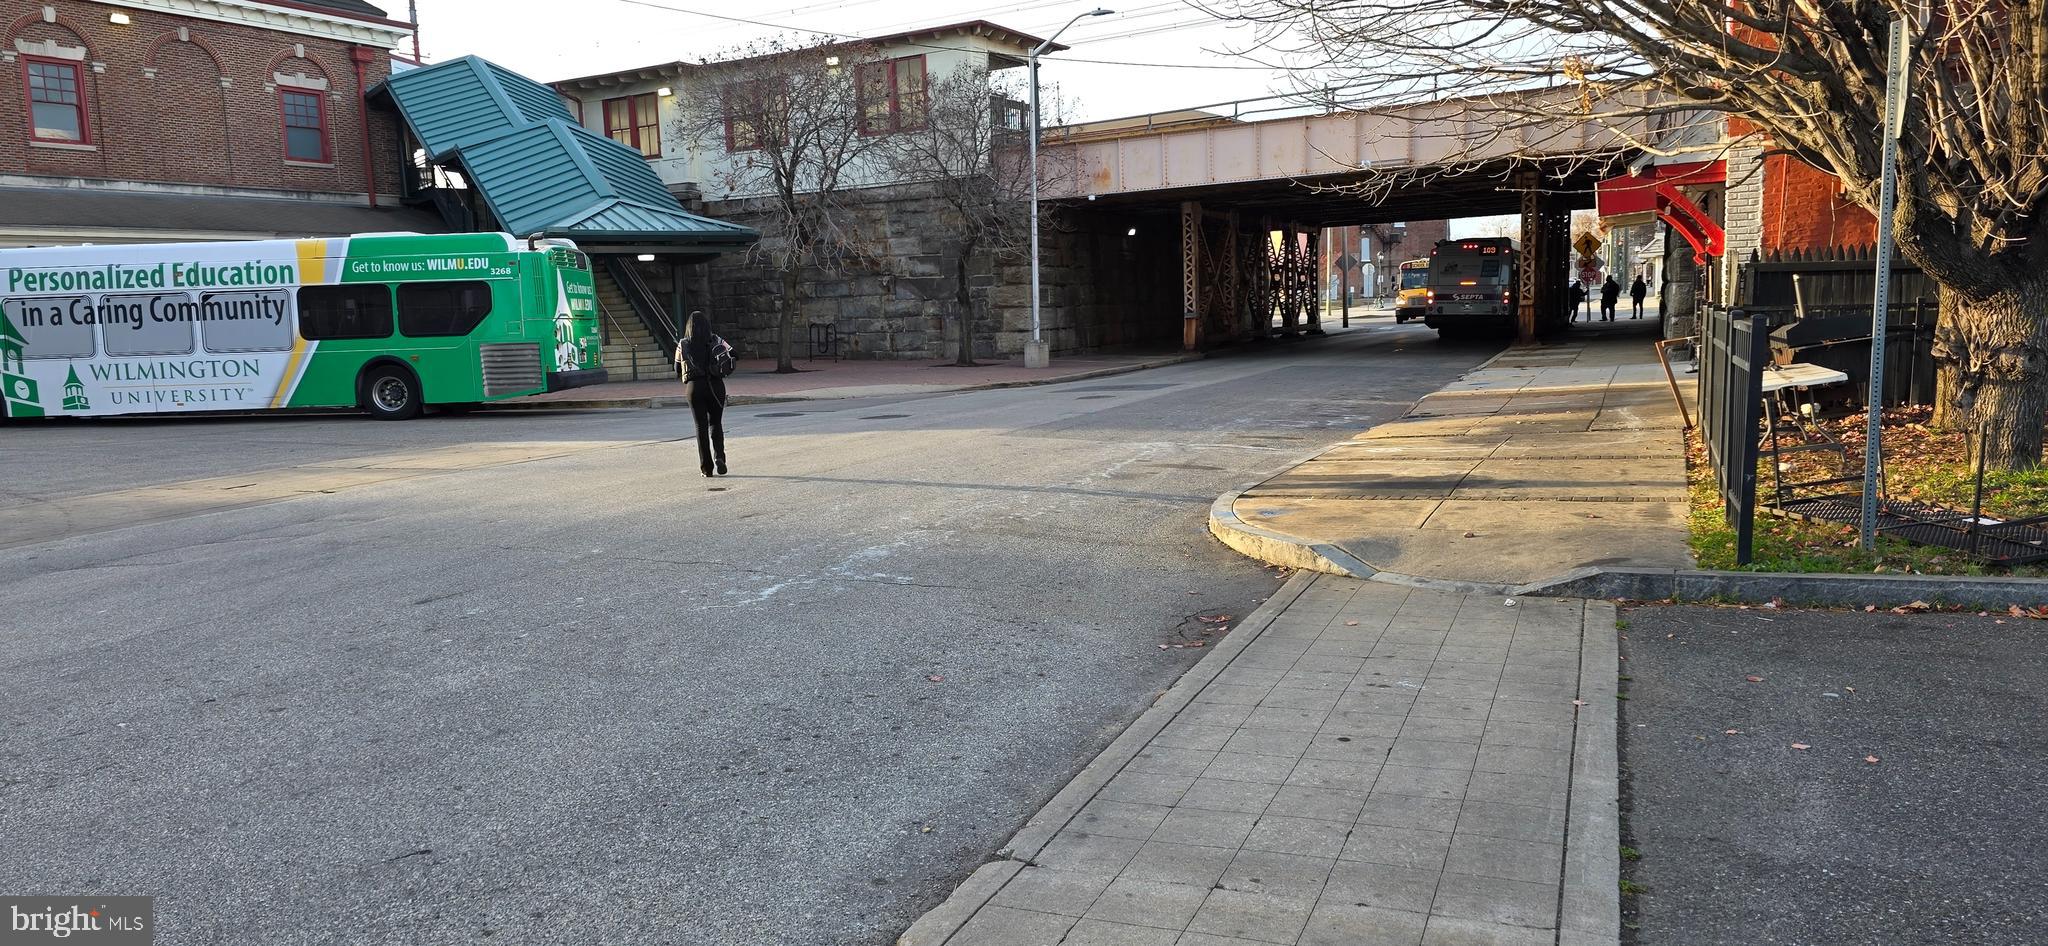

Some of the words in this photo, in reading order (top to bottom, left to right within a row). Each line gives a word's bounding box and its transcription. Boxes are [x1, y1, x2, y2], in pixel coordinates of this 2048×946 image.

[352, 261, 369, 273] Get
[370, 262, 381, 273] to
[383, 260, 410, 272] know
[411, 261, 426, 271] us:
[427, 257, 489, 271] WILMU.EDU
[490, 267, 512, 275] 3268
[9, 263, 165, 292] Personalized
[173, 260, 295, 289] Education
[22, 300, 43, 326] in
[50, 307, 63, 325] a
[69, 297, 143, 330] Caring
[150, 293, 285, 326] Community
[90, 359, 260, 381] WILMINGTON
[111, 388, 247, 405] UNIVERSITY
